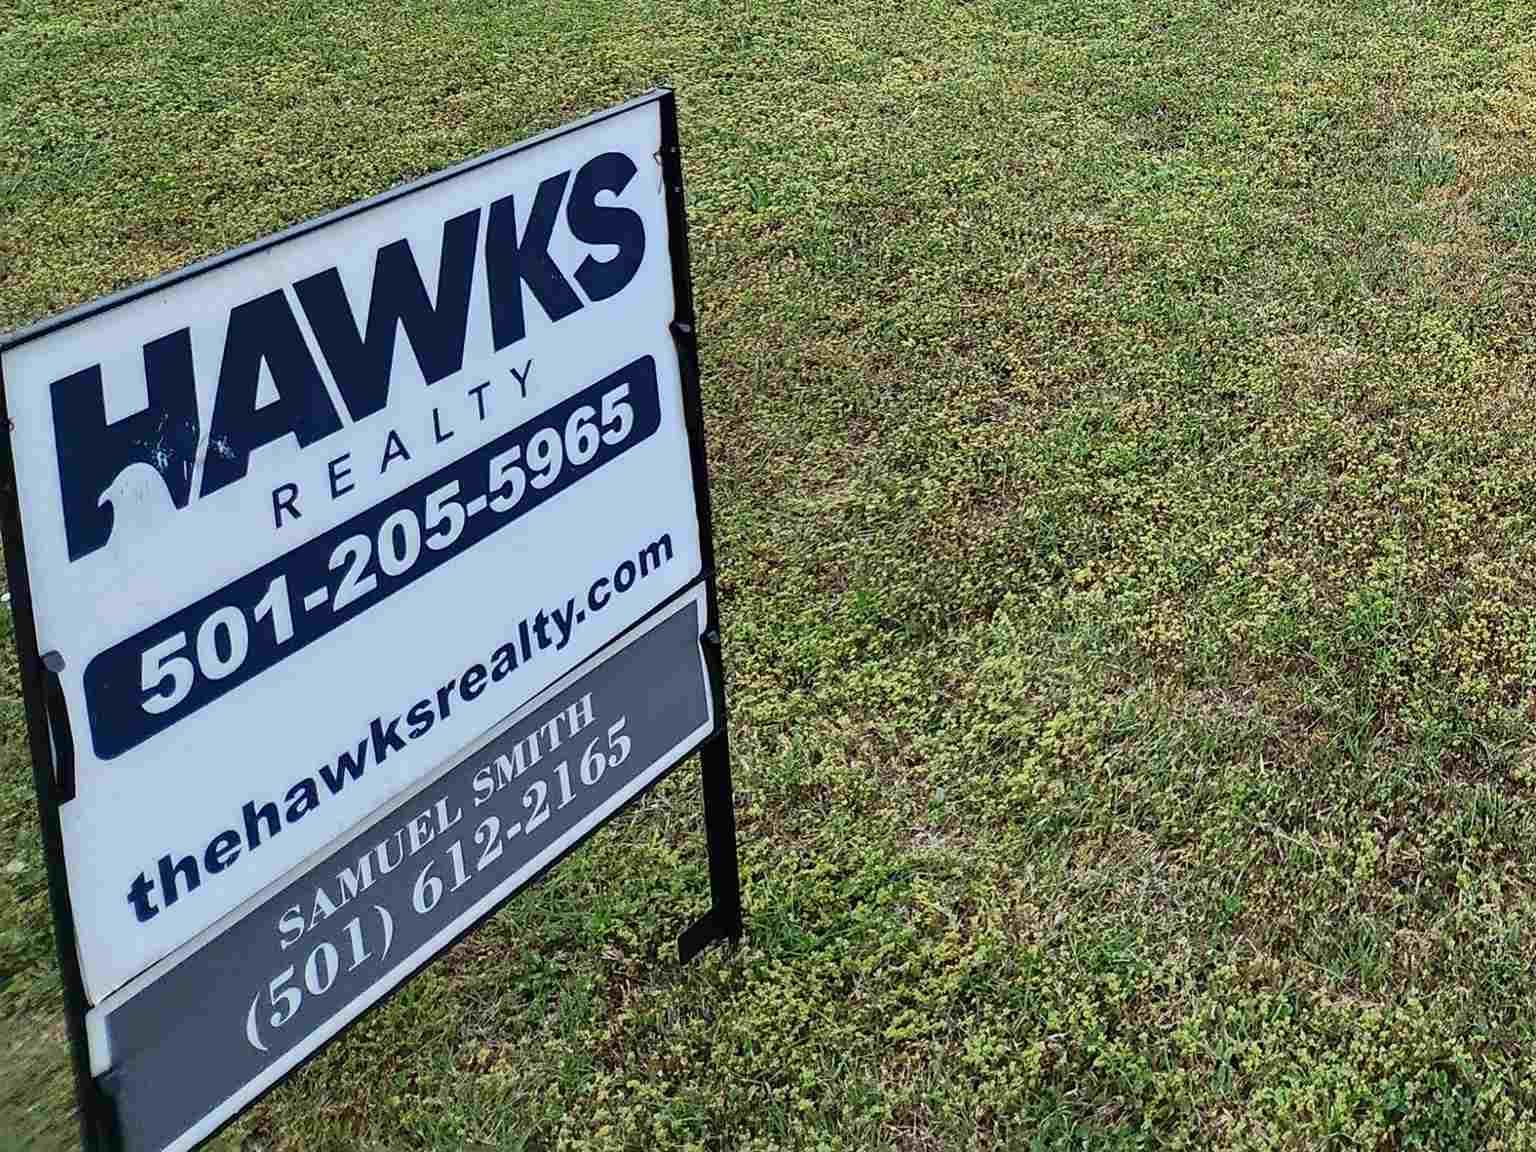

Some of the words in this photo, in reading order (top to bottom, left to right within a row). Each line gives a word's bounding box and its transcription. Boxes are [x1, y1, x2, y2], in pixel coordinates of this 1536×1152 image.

[49, 150, 649, 562] HAWKS
[270, 358, 535, 529] REALTY
[139, 381, 635, 716] 501-205-5965
[127, 529, 675, 924] thehawksrealty.com
[245, 902, 396, 1052] (501)
[411, 715, 634, 917] 612-2165
[277, 794, 464, 949] SAMUEL
[471, 692, 597, 807] SMITH
